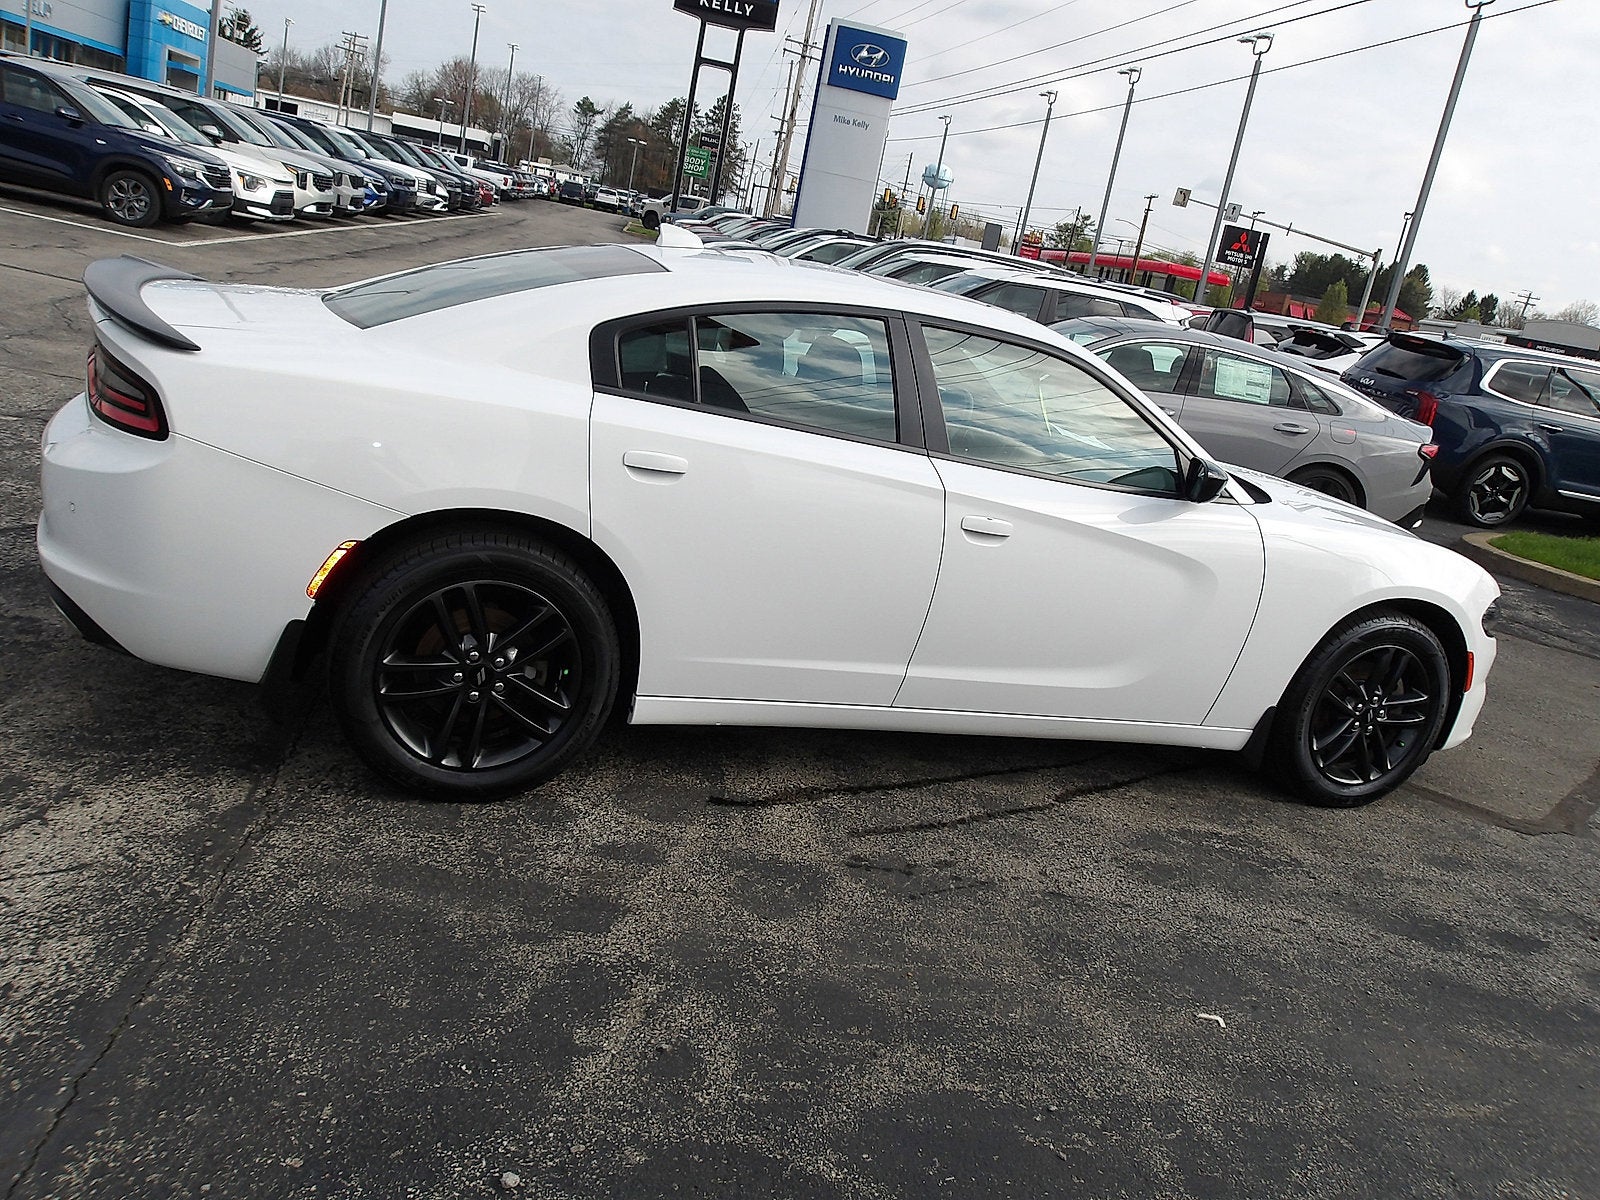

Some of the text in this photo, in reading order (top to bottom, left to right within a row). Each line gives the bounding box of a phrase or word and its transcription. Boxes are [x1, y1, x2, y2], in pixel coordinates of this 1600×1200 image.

[700, 0, 754, 17] KELLY
[173, 15, 206, 41] CHEVROLET
[838, 63, 895, 84] HYUNDAI
[833, 114, 870, 131] Mike Kelly
[683, 163, 705, 172] SHOP
[684, 156, 706, 166] BODY
[1224, 250, 1253, 260] MITSUBSHI
